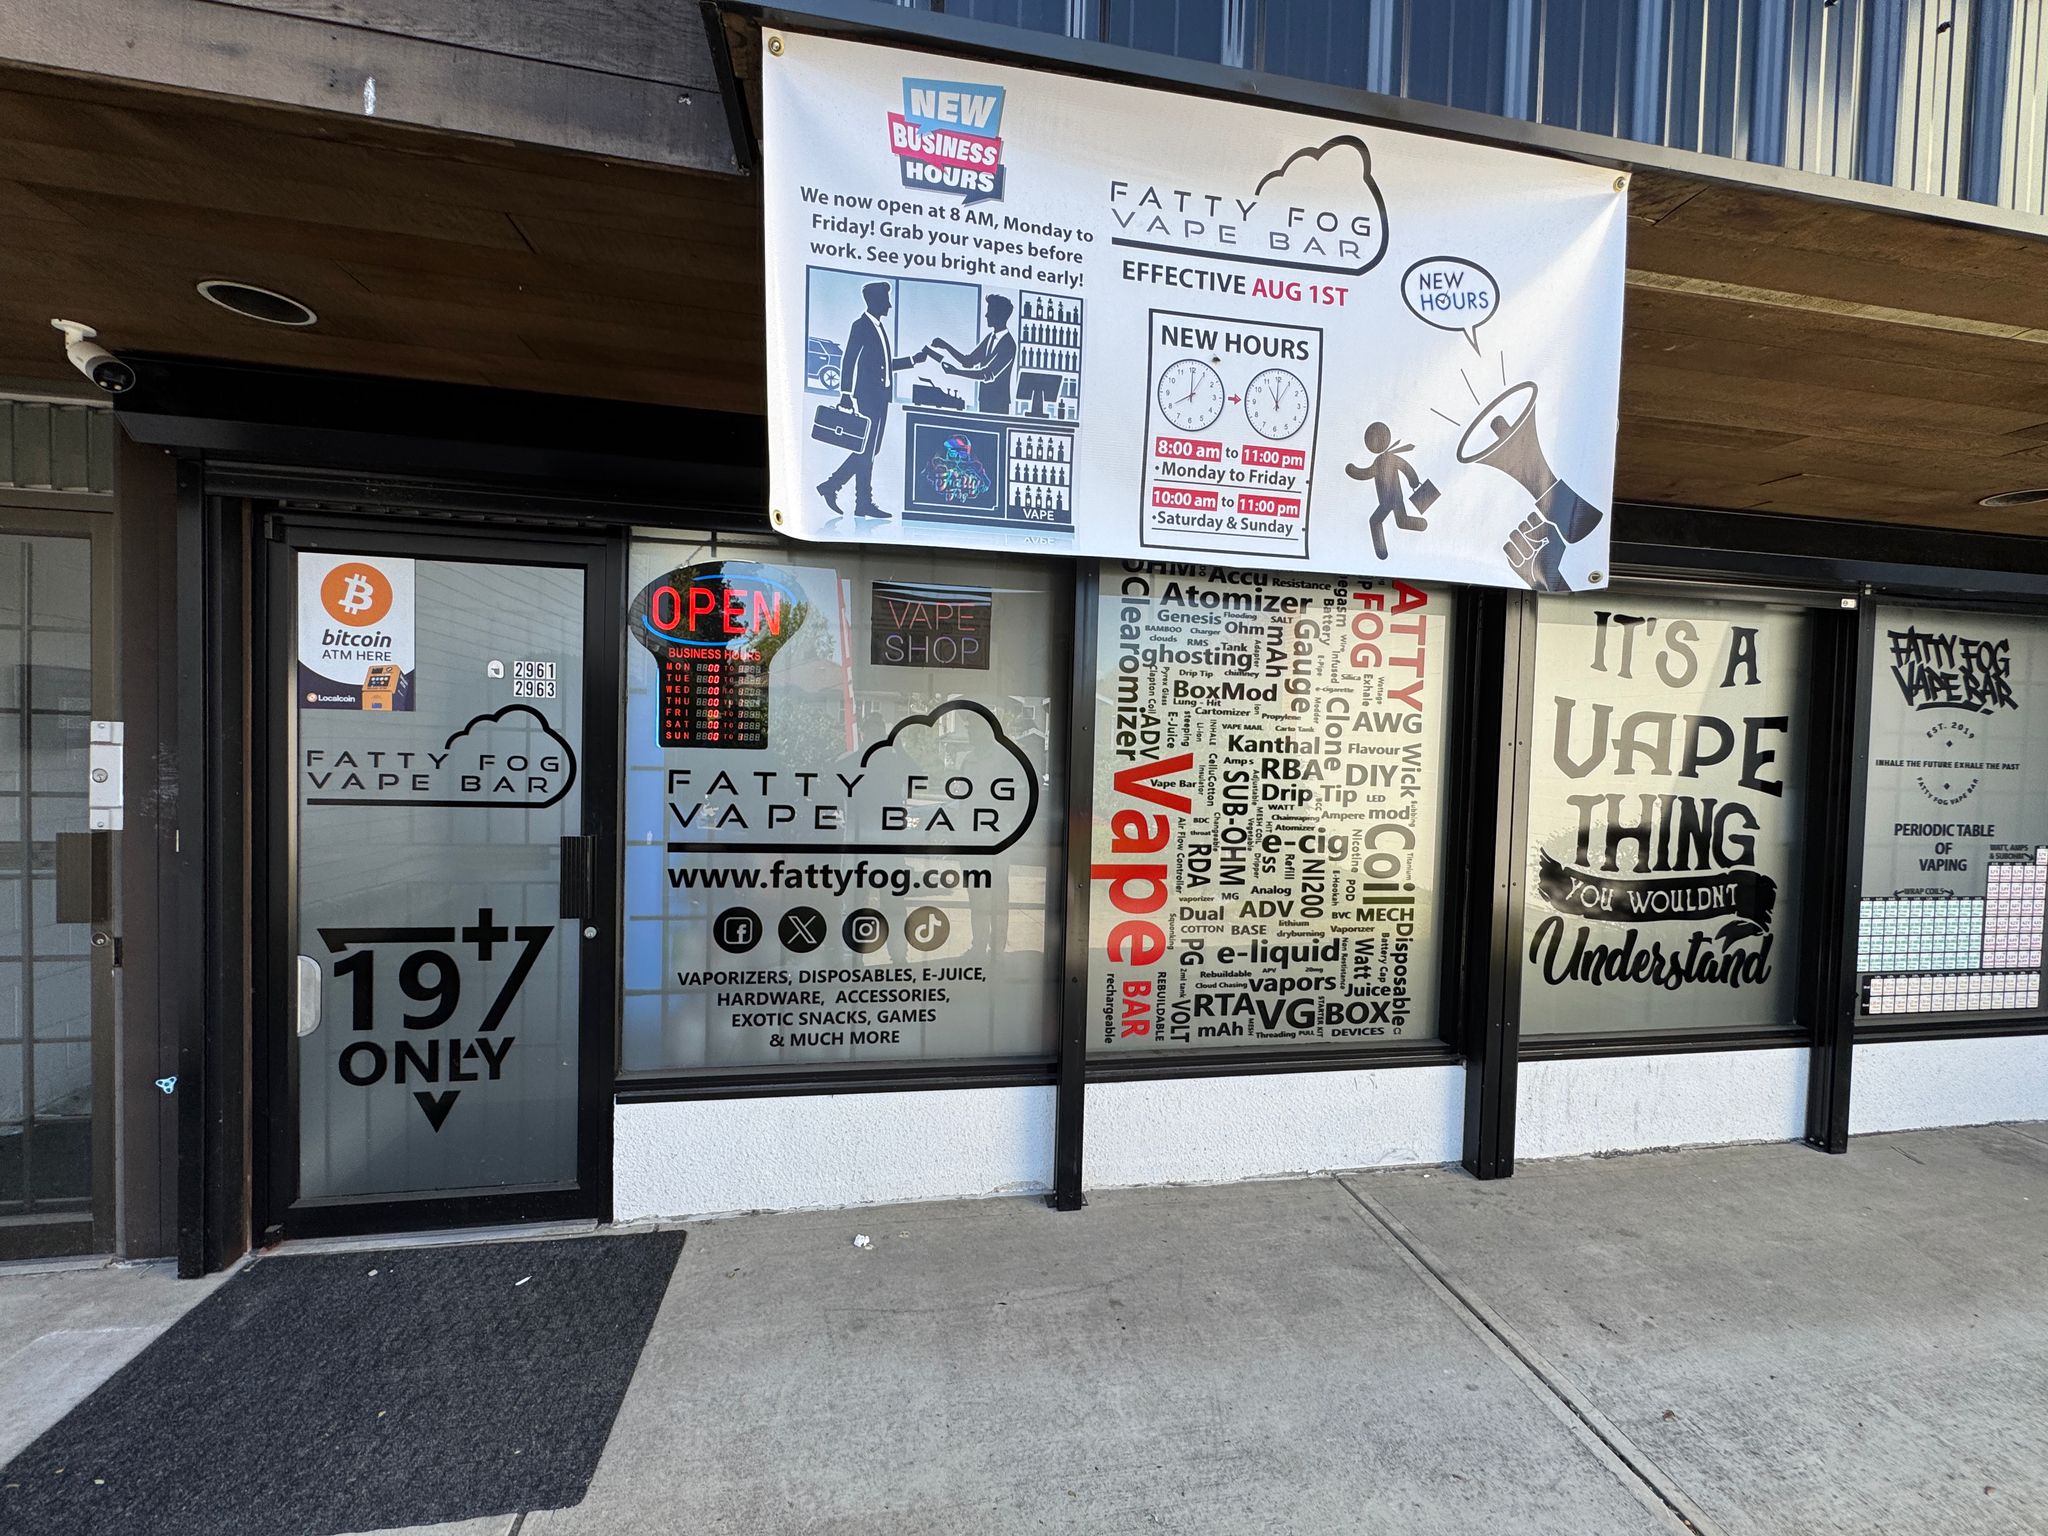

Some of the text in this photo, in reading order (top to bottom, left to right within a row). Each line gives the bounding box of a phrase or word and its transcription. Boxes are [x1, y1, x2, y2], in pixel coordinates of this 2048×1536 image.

[910, 88, 996, 128] NEW
[893, 122, 997, 166] BUSINESS
[906, 162, 994, 193] HOURS
[801, 186, 1094, 242] We now open at 8 AM, Monday to
[1111, 181, 1370, 237] FATTY FOG
[813, 214, 1083, 264] Friday! Grab your vapes before
[1112, 208, 1360, 259] VAPE BAR
[811, 241, 1084, 288] work. See you bright and early!
[1123, 260, 1349, 306] EFFECTIVE AUG 1ST
[1419, 272, 1464, 290] NEW
[1421, 290, 1489, 311] HOURS
[1162, 325, 1309, 360] NEW HOURS
[1158, 440, 1303, 469] 8:00 am to 11:00 pm
[1162, 461, 1296, 489] Monday to Friday
[1023, 508, 1054, 521] VAPE
[1154, 490, 1299, 516] 10:00 am to 11:00 pm
[1158, 511, 1293, 536] Saturday & Sunday
[1272, 578, 1331, 591] Resistance
[1160, 582, 1313, 614] Atomizer
[652, 586, 781, 636] OPEN
[889, 601, 977, 632] VAPE
[1157, 609, 1222, 625] Genesis
[1224, 612, 1257, 621] Flooding
[322, 629, 392, 648] bitcoin
[1225, 621, 1264, 635] Ohm
[1350, 593, 1384, 668] FOG
[322, 650, 392, 662] ATM HERE
[668, 648, 761, 662] BUSINESS HOURS
[885, 634, 980, 664] SHOP
[1142, 644, 1252, 672] ghosting
[1589, 610, 1762, 689] IT'S A
[1887, 625, 2011, 678] FATTY FOG
[513, 661, 556, 679] 2961
[666, 662, 690, 672] MON
[1116, 577, 1149, 761] Clearomizer
[513, 680, 556, 698] 2963
[666, 674, 690, 684] TUE
[666, 685, 690, 695] WED
[1890, 660, 2019, 710] VAPE BAR
[318, 694, 356, 703] Localcoin
[666, 697, 690, 707] THU
[1174, 680, 1277, 702] BoxMod
[666, 708, 688, 718] FRI
[1195, 707, 1251, 717] Cartomizer
[1352, 712, 1422, 734] AWG
[666, 719, 690, 729] SAT
[1926, 722, 1975, 739] EST. 2019
[666, 731, 690, 741] SUN
[1228, 734, 1320, 754] Kanthal
[1553, 695, 1789, 798] VAPE
[307, 750, 559, 772] FATTY FOG
[1261, 758, 1324, 780] RBA
[1876, 759, 1904, 767] INHALE
[307, 772, 549, 793] VAPE BAR
[668, 769, 1015, 801] FATTY FOG
[1346, 764, 1398, 787] DIY
[1262, 784, 1358, 807] Drip Tip
[1917, 776, 1979, 806] FATTY FOG VAPE BAR
[669, 803, 1001, 832] VAPE BAR
[1220, 771, 1249, 885] SUB-OHM
[1566, 793, 1761, 873] THING
[1894, 823, 1995, 837] PERIODIC TABLE
[1091, 752, 1193, 966] Vape
[1934, 842, 1953, 855] OF
[1187, 844, 1212, 889] RDA
[1363, 824, 1416, 904] Coil
[1919, 859, 1968, 871] VAPING
[668, 860, 992, 896] www.fattyfog.com
[1566, 876, 1613, 911] YOU
[1180, 906, 1225, 921] Dual
[1356, 908, 1414, 922] MECH
[1181, 925, 1224, 933] COTTON
[1217, 938, 1339, 970] e-liquid
[1528, 915, 1773, 991] Understand
[678, 967, 987, 986] VAPORIZERS, DISPOSABLES, E-JUICE,
[1249, 976, 1336, 995] vapors
[1390, 923, 1413, 1026] Disposable
[717, 988, 950, 1007] HARDWARE, ACCESSORIES,
[1194, 993, 1255, 1017] RTA
[732, 1008, 937, 1028] EXOTIC SNACKS, GAMES
[1121, 981, 1151, 1038] BAR
[1256, 998, 1315, 1029] VG
[1326, 1001, 1391, 1025] BOX
[769, 1030, 900, 1048] & MUCH MORE
[1332, 1027, 1384, 1037] DEVICES
[338, 1036, 516, 1087] ONLY
